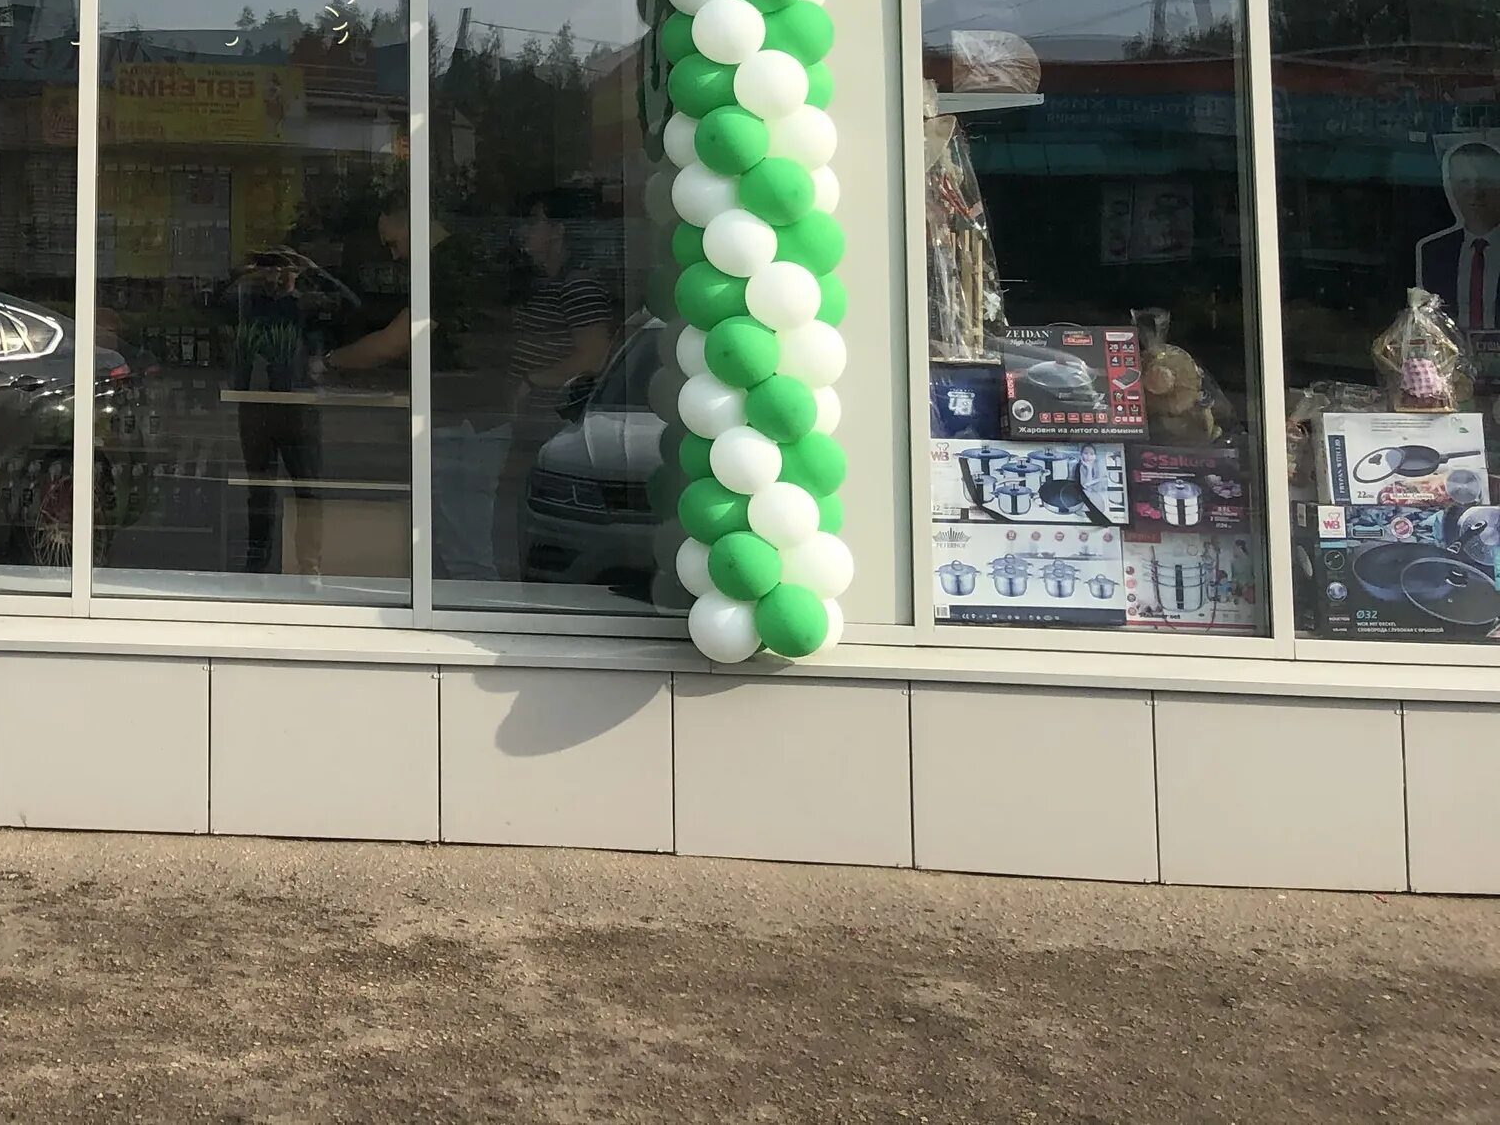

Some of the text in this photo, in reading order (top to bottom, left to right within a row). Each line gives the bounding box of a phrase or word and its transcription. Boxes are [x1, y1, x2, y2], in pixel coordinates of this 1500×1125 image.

[1005, 330, 1050, 339] ZEIDAN
[1009, 339, 1048, 347] High Quality
[1018, 426, 1056, 434] Жаровня
[1158, 455, 1217, 469] Sakura
[1323, 520, 1341, 530] WB
